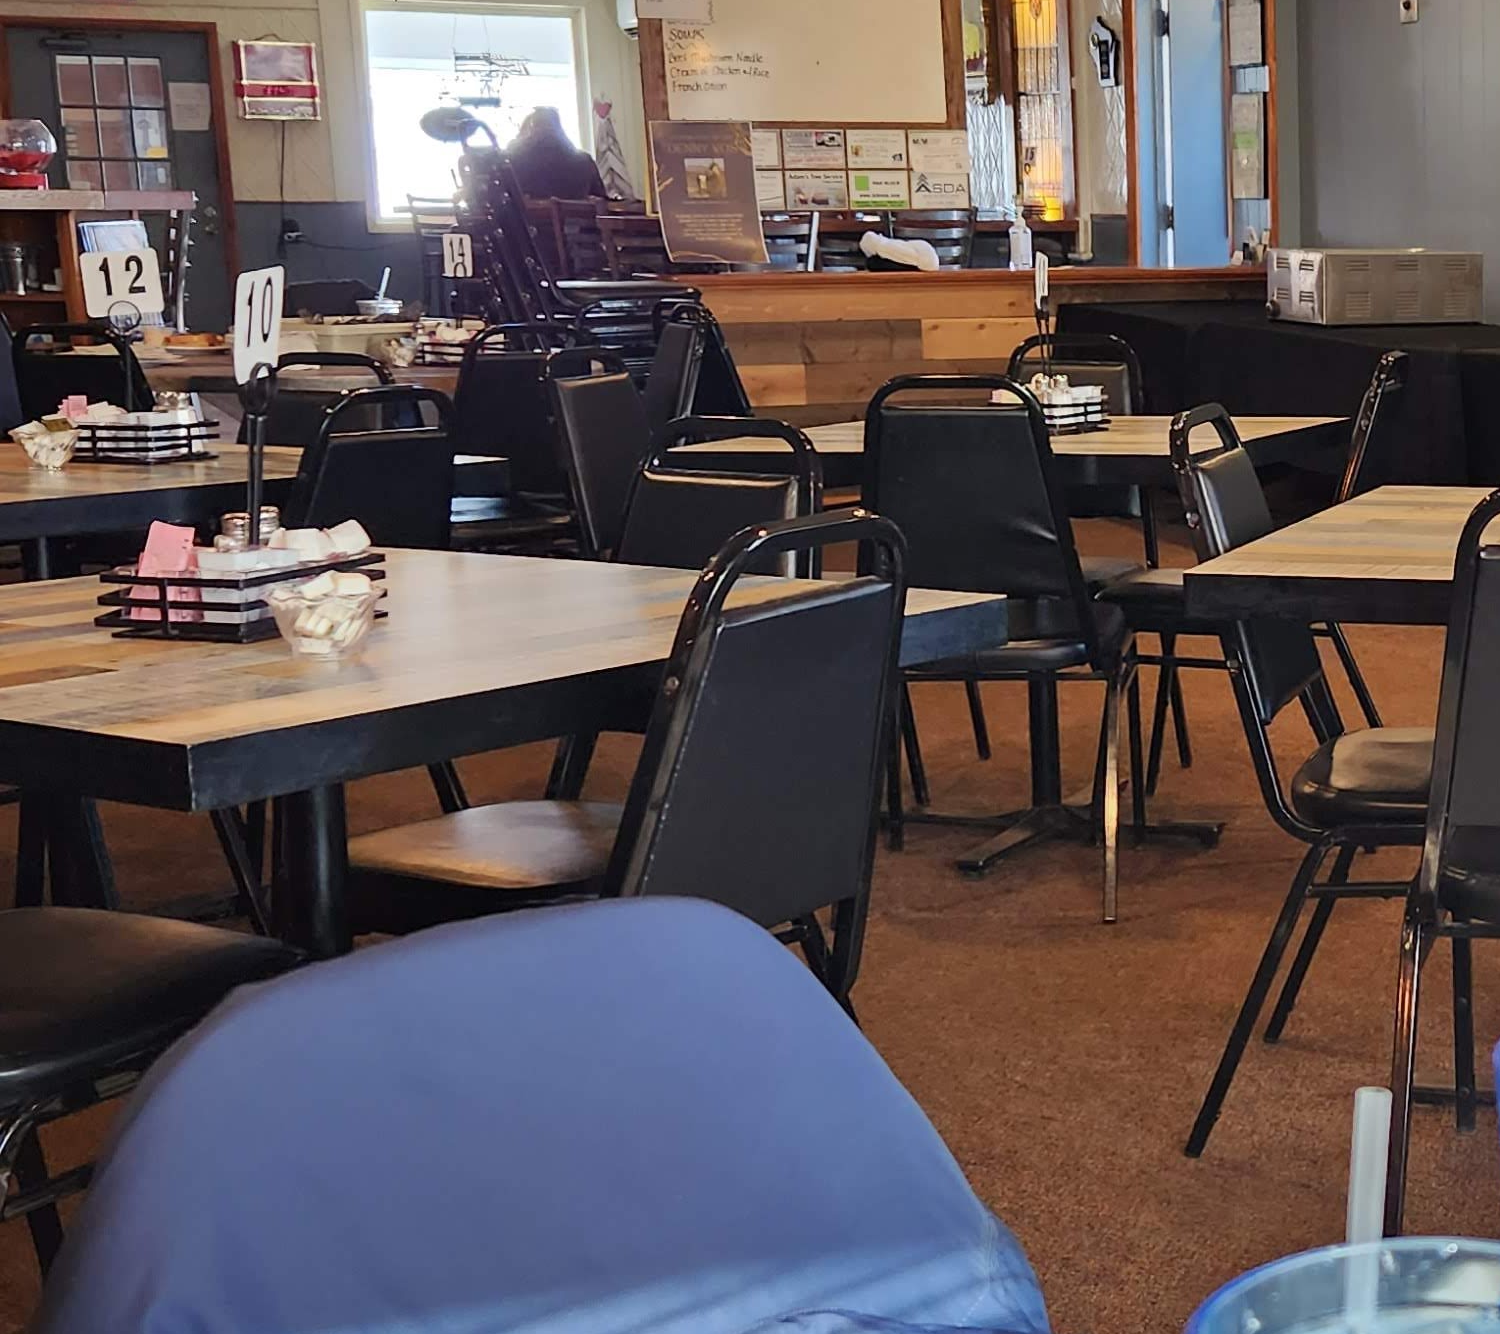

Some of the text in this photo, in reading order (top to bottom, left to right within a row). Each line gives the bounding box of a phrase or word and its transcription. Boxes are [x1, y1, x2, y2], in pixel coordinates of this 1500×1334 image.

[1025, 148, 1035, 161] 15
[449, 237, 466, 264] 14
[99, 255, 147, 297] 12
[246, 276, 274, 349] 10
